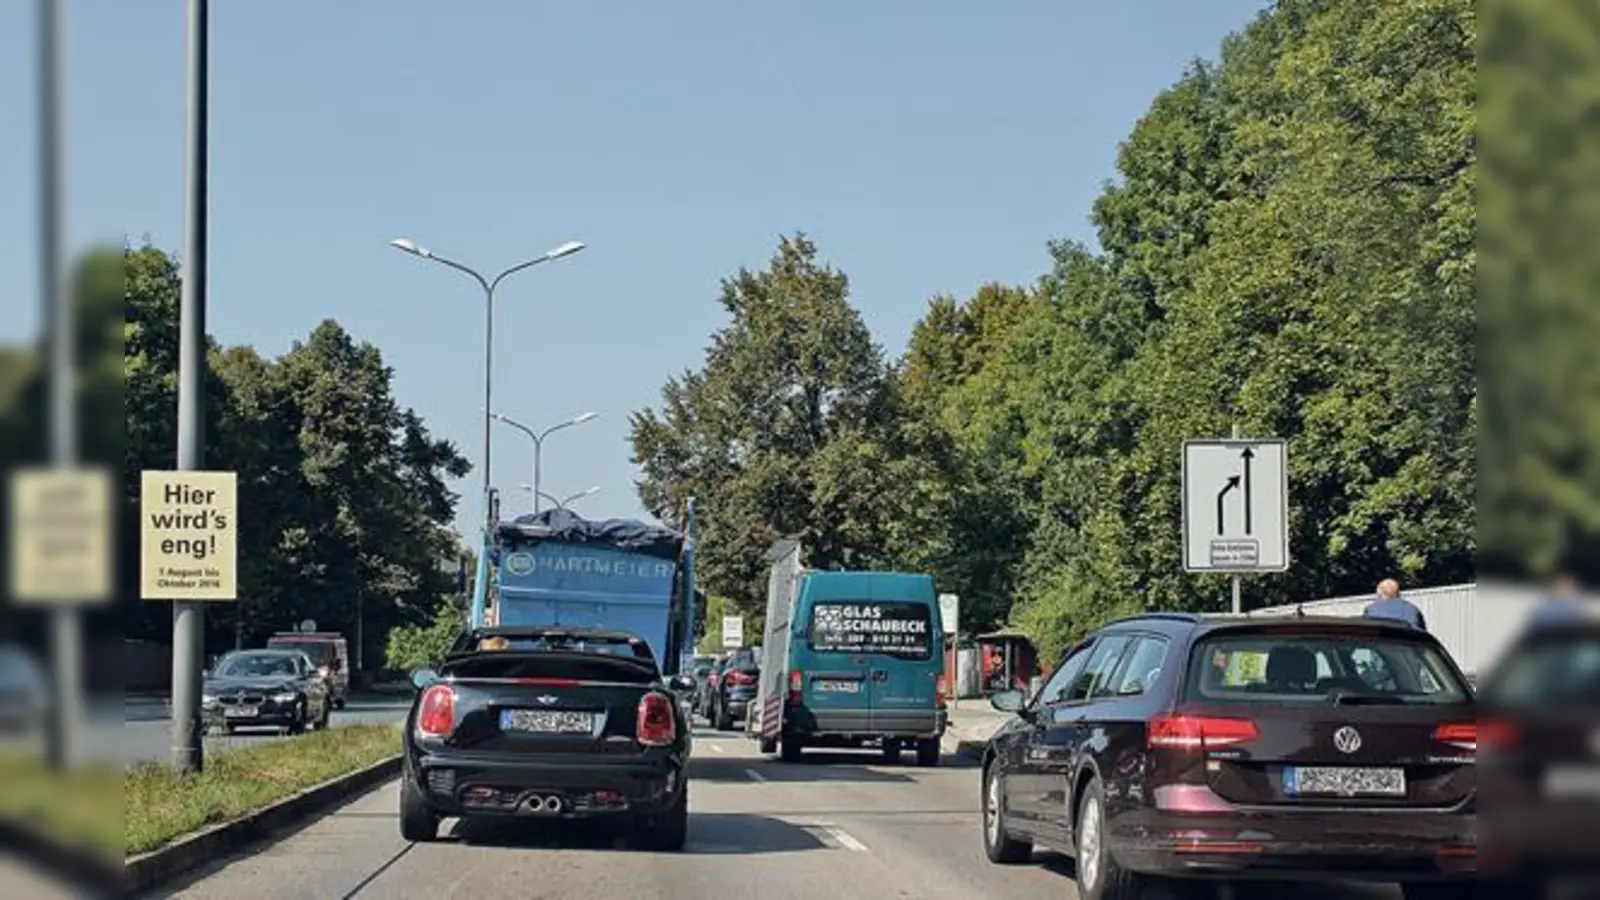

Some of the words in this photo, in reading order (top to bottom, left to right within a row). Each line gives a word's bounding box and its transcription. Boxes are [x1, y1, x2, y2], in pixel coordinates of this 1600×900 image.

[164, 483, 216, 505] Hier
[151, 508, 228, 530] wird's
[161, 535, 216, 560] eng!
[167, 568, 202, 578] August
[539, 555, 669, 578] HARTMEIER
[157, 579, 197, 588] Oktober
[843, 606, 881, 618] GLAS
[844, 619, 926, 633] SCHAUBECK
